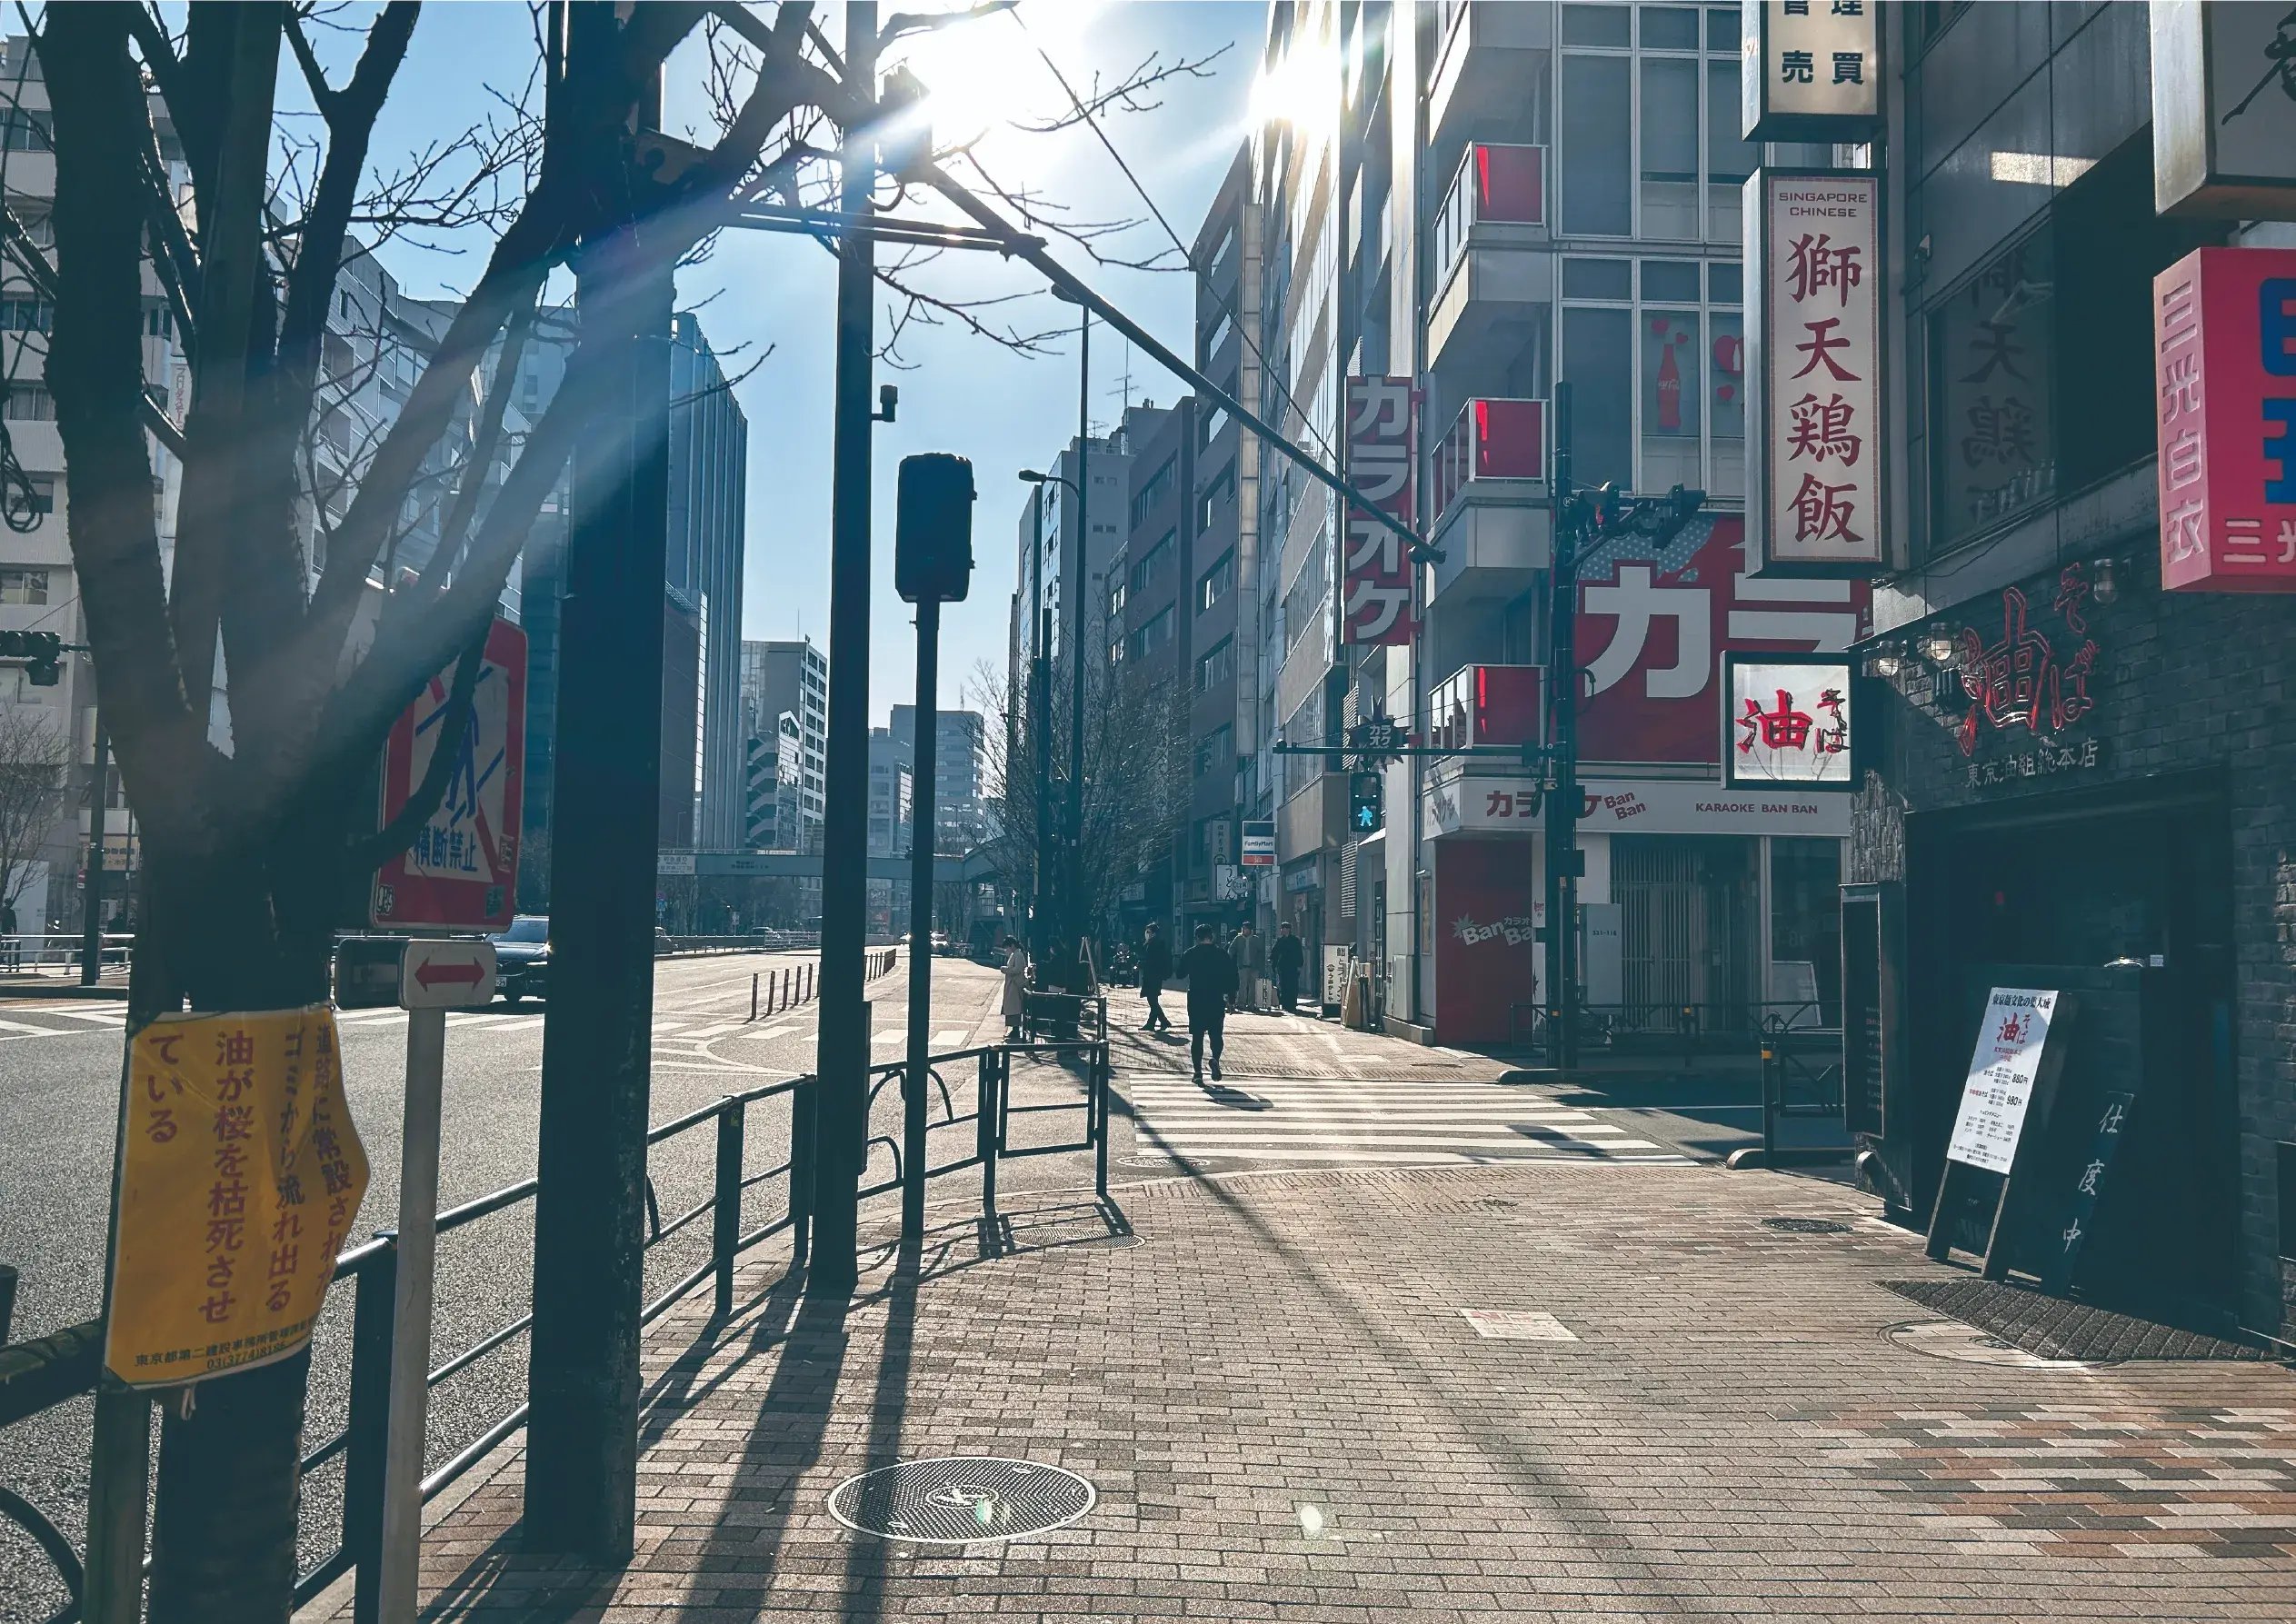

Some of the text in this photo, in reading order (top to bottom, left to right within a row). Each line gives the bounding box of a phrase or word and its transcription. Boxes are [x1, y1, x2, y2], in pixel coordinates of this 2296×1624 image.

[1782, 50, 1865, 85] 売買
[1779, 192, 1868, 203] SINGAPORE
[1790, 207, 1857, 217] CHINESE
[1785, 233, 1864, 544] 獅天鶏飯
[1346, 378, 1413, 640] カラオケ
[1964, 736, 2099, 790] 東京油組総本店
[1486, 790, 1602, 818] カラケ
[1604, 790, 1635, 809] Ban
[1615, 802, 1647, 820] Ban
[1695, 802, 1819, 814] KARAOKE BAN BAN
[1462, 922, 1532, 946] Ban Ba
[145, 1034, 185, 1144] ている
[198, 1031, 255, 1324] 油が桜を枯死させ
[2062, 1102, 2124, 1253] 仕度中
